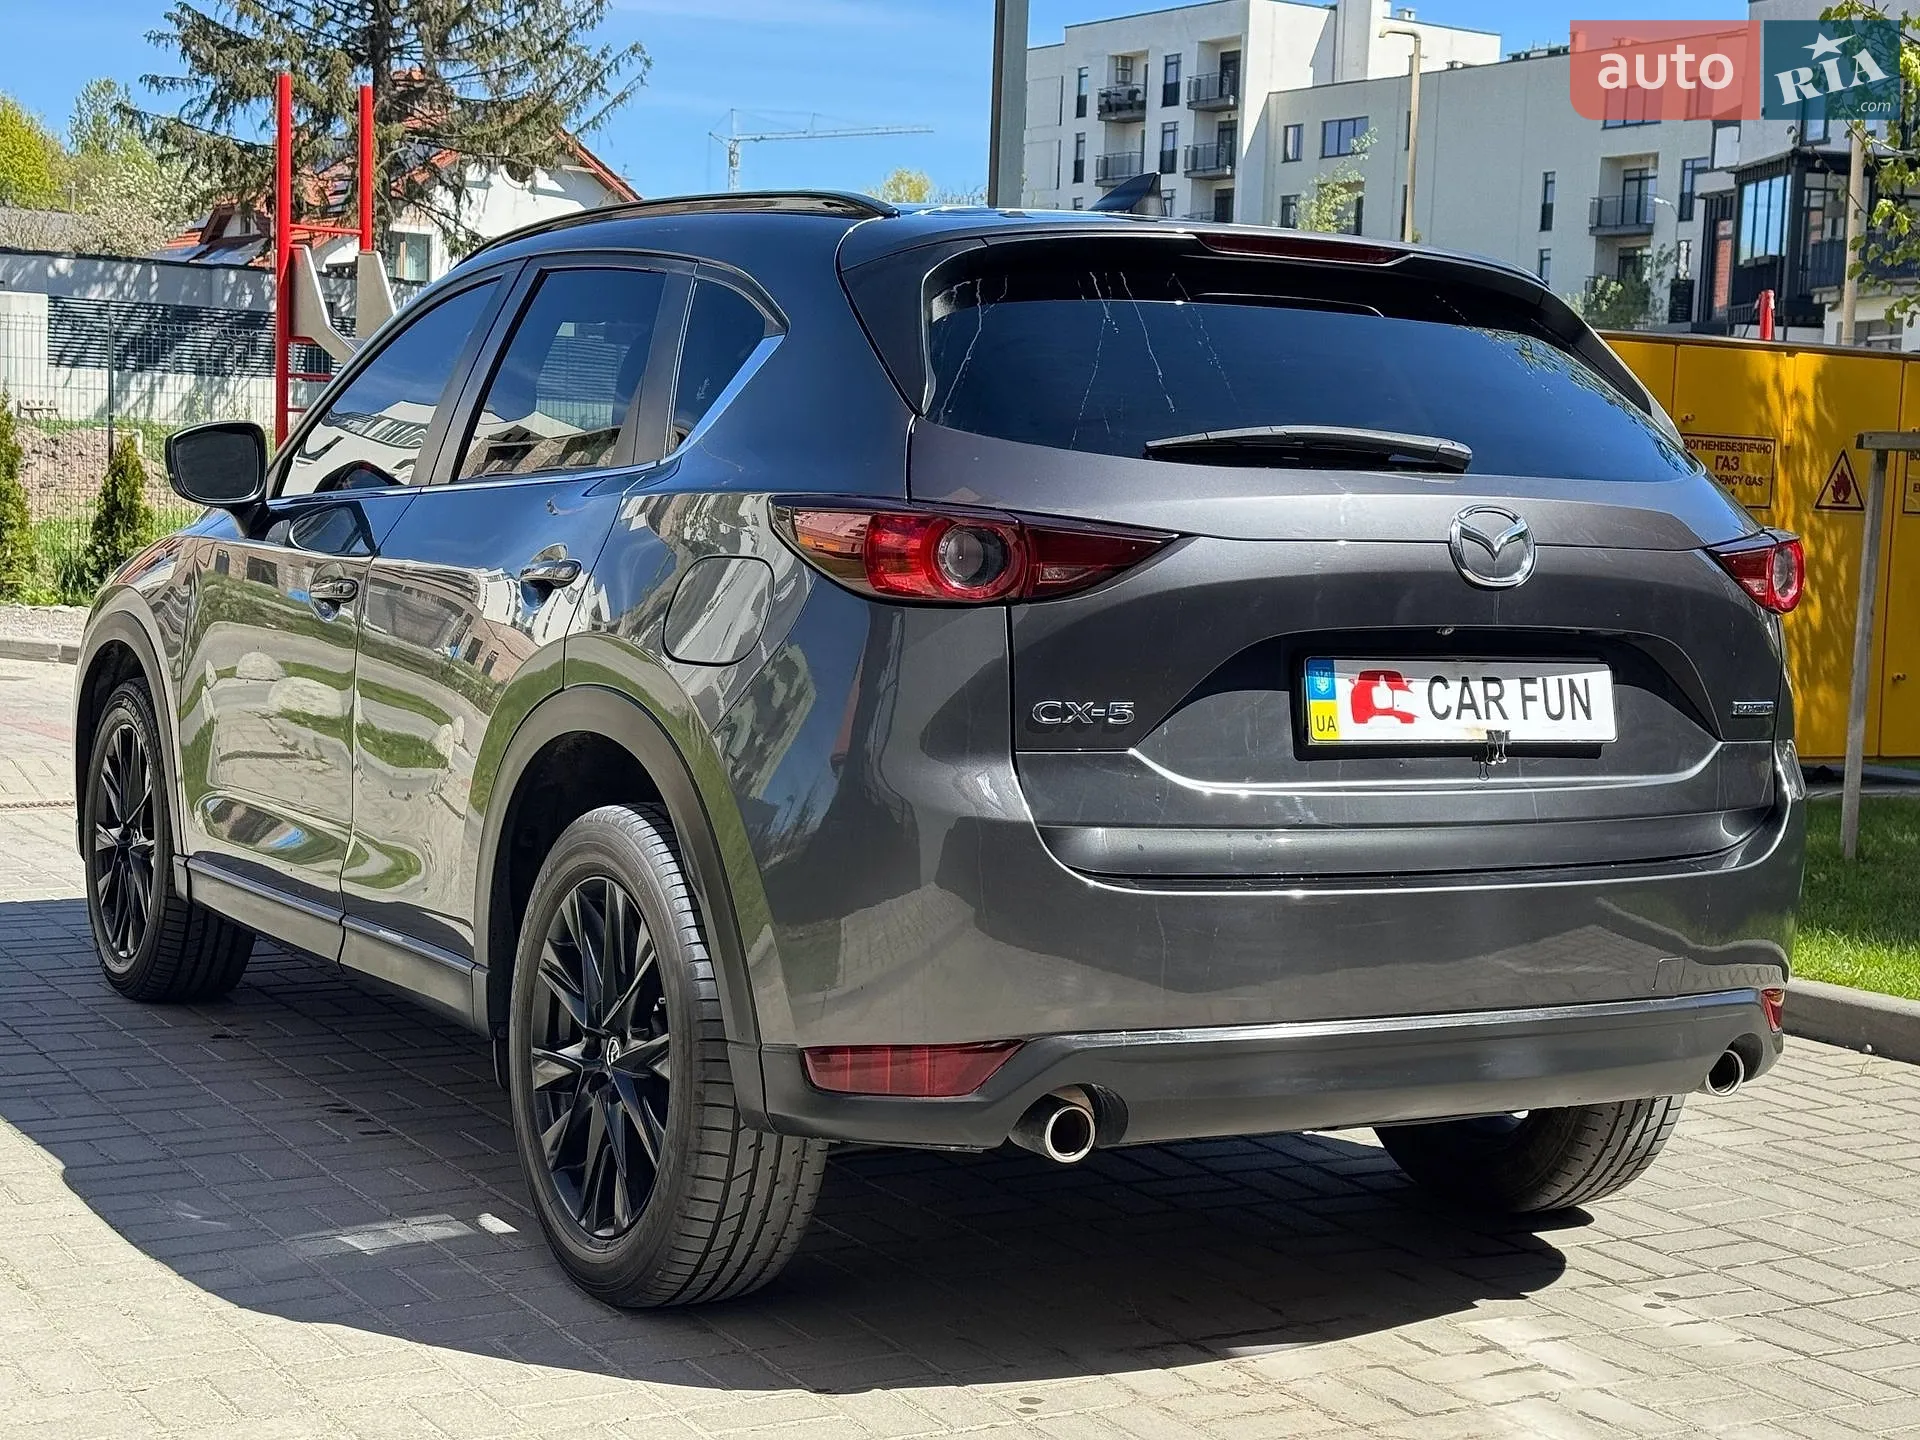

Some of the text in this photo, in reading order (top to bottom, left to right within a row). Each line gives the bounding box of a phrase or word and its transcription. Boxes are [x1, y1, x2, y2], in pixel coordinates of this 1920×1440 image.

[1715, 455, 1740, 471] ГАЗ
[1745, 475, 1764, 487] GAS
[1428, 675, 1593, 721] CAR FUN
[1032, 700, 1135, 725] CX-5
[1316, 714, 1337, 732] UA
